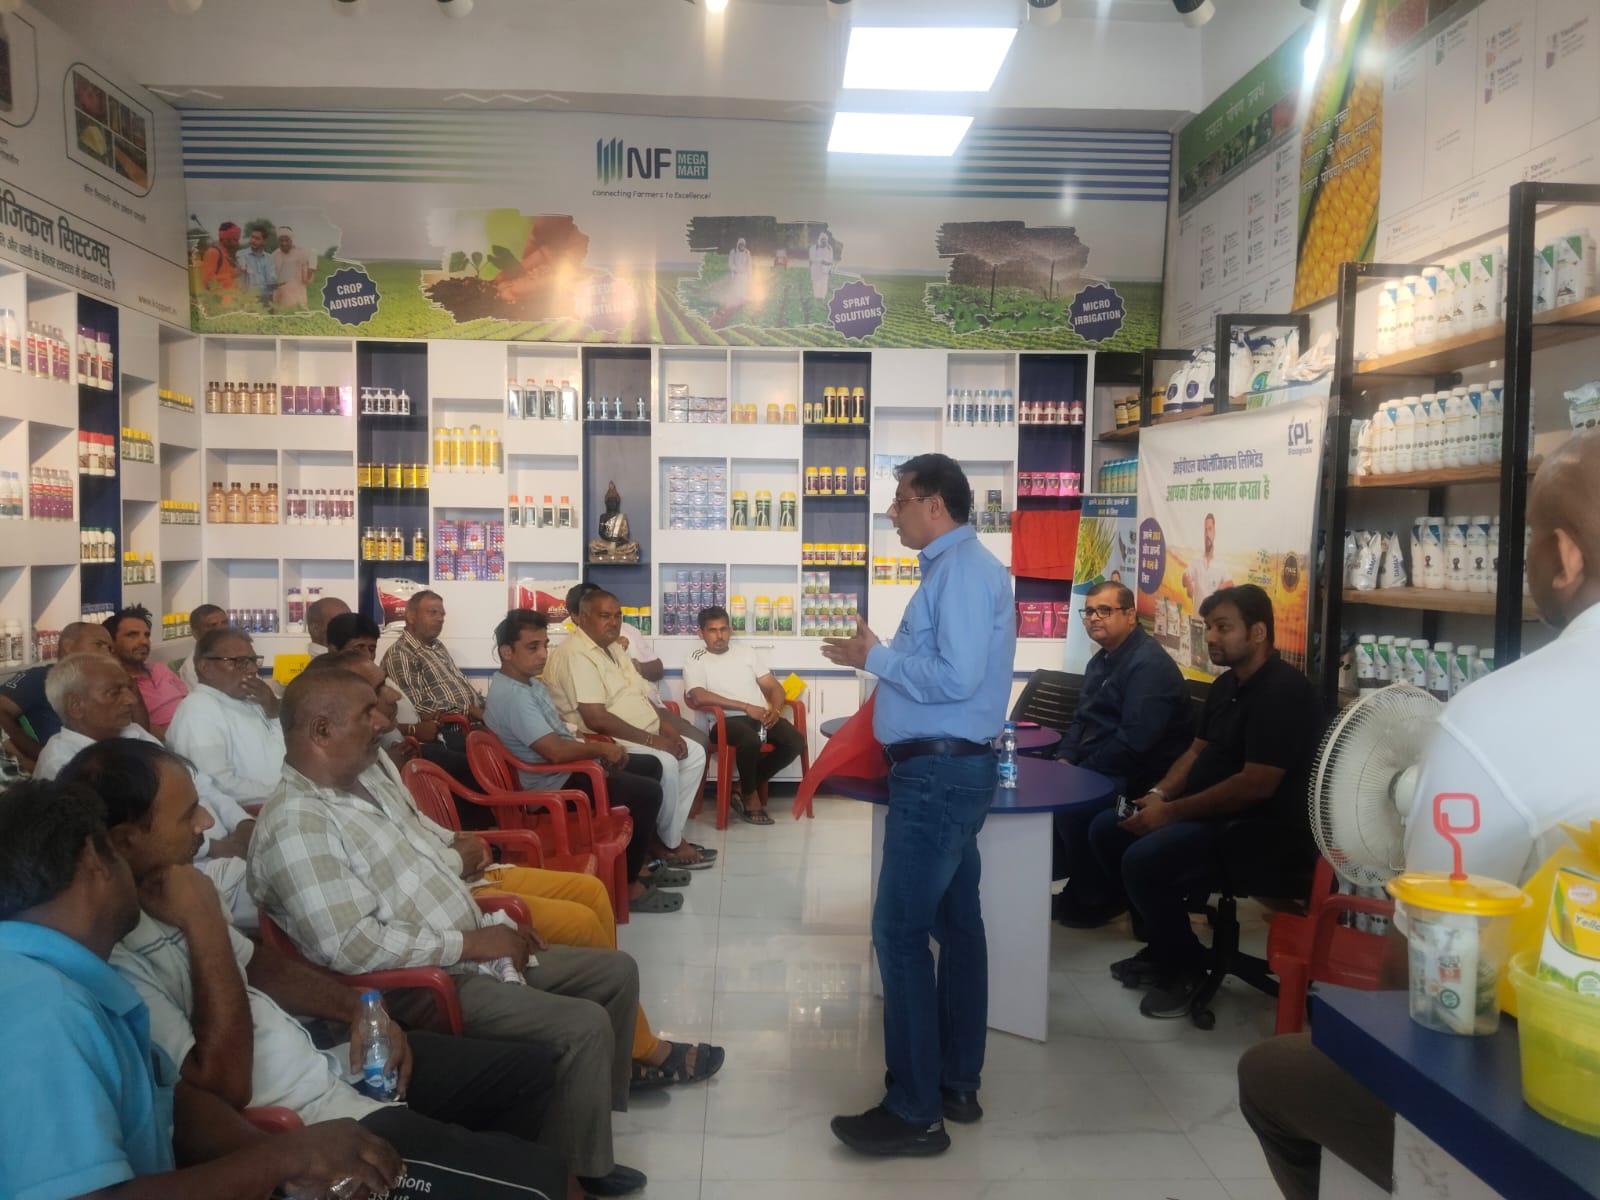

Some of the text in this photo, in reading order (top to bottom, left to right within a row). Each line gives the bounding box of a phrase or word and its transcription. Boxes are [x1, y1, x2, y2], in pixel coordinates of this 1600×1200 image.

[627, 147, 672, 179] NF
[678, 153, 706, 165] MEGA
[678, 165, 706, 177] MART
[592, 188, 632, 199] Connecting
[632, 190, 664, 199] Farmers
[665, 191, 674, 199] to
[0, 189, 54, 246] जिकल
[337, 283, 362, 296] CROP
[330, 295, 376, 310] ADVISORY
[843, 296, 870, 309] SPRAY
[1083, 299, 1111, 312] MICRO
[835, 307, 882, 323] SOLUTIONS
[1075, 310, 1121, 326] IRRIGATION
[1288, 421, 1313, 447] IPL
[1238, 449, 1264, 469] लिमिटेड
[1167, 474, 1271, 502] आपका हार्दिक स्वागत करता है
